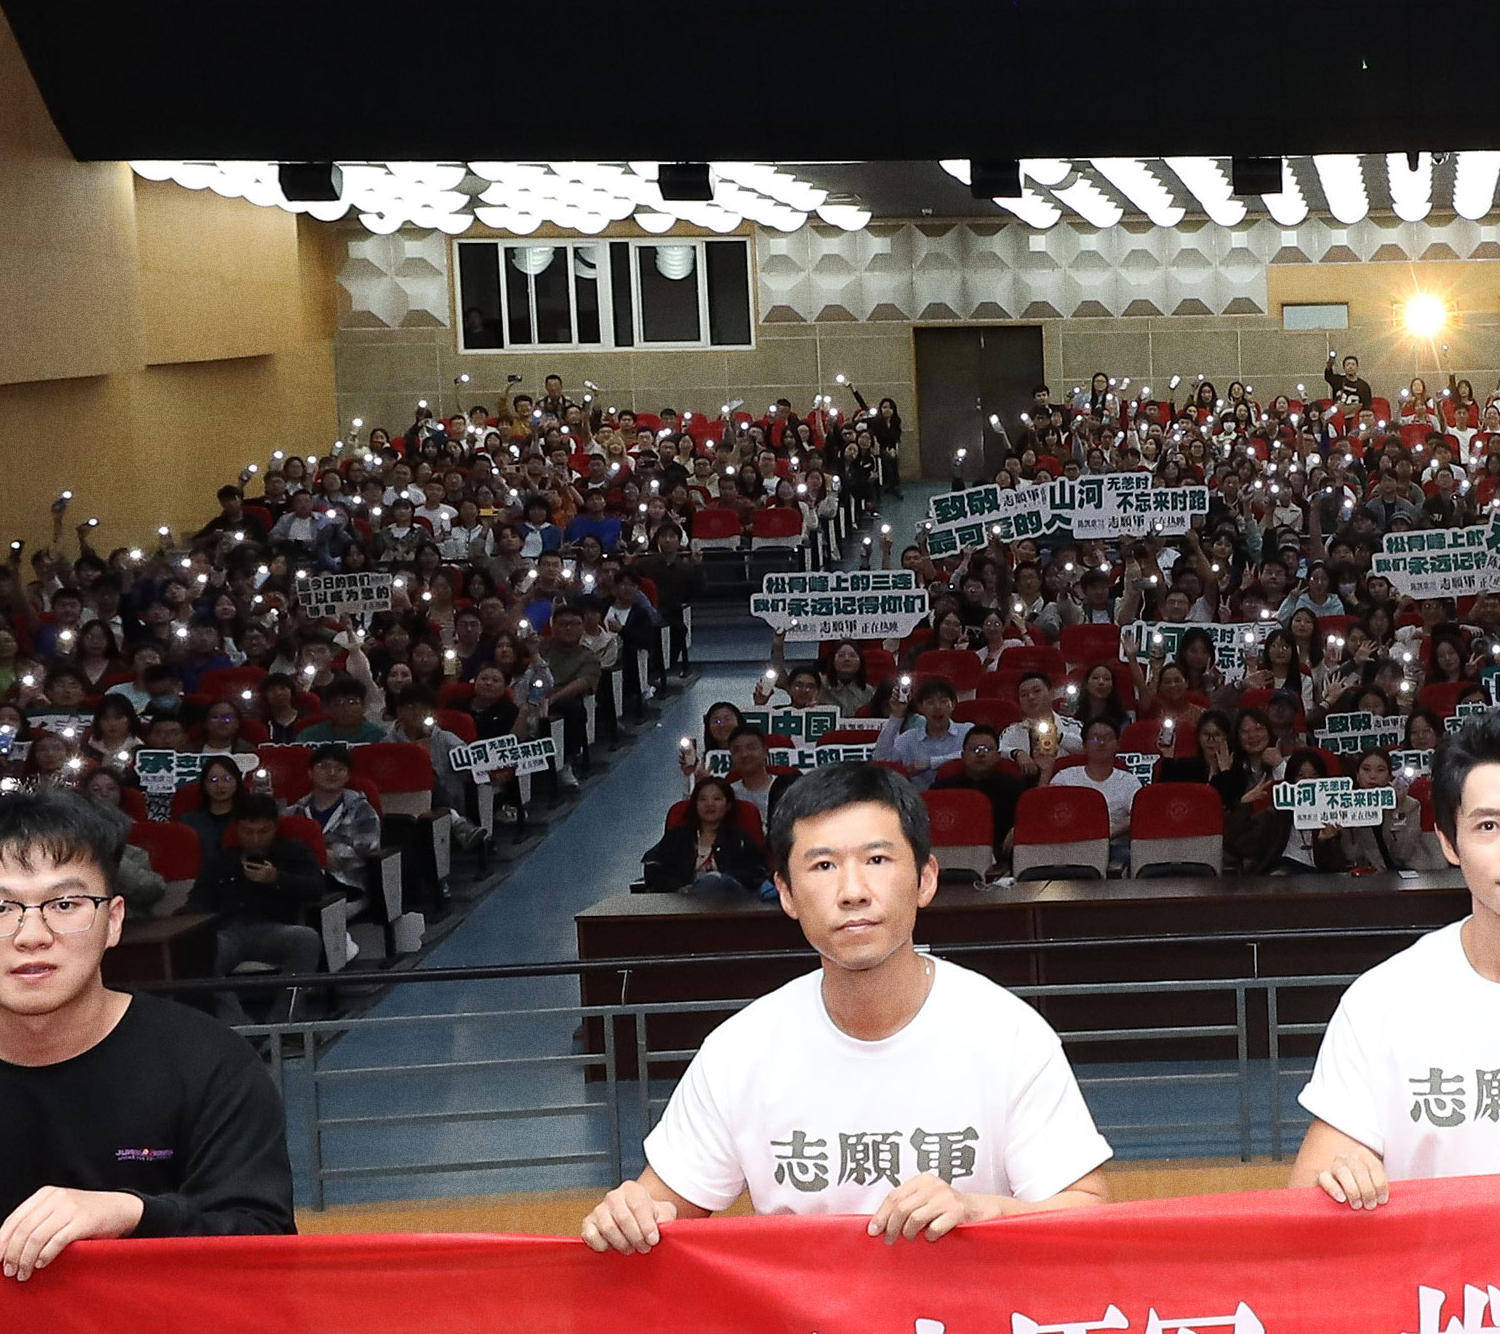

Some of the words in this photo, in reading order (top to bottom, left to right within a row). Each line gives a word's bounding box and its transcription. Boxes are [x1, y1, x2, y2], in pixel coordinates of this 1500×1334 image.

[1050, 479, 1104, 510] 山河
[1107, 476, 1149, 491] 无恙时
[1116, 490, 1207, 514] 不忘来时路
[934, 488, 1000, 524] 致敬
[766, 573, 913, 594] 松骨峰上的三连
[753, 594, 927, 617] 我们永远记得你们
[452, 743, 491, 768] 山河
[1275, 782, 1317, 807] 山河
[1318, 780, 1351, 793] 无恙时
[1325, 790, 1394, 809] 不忘来时路
[770, 1126, 980, 1193] 志願軍
